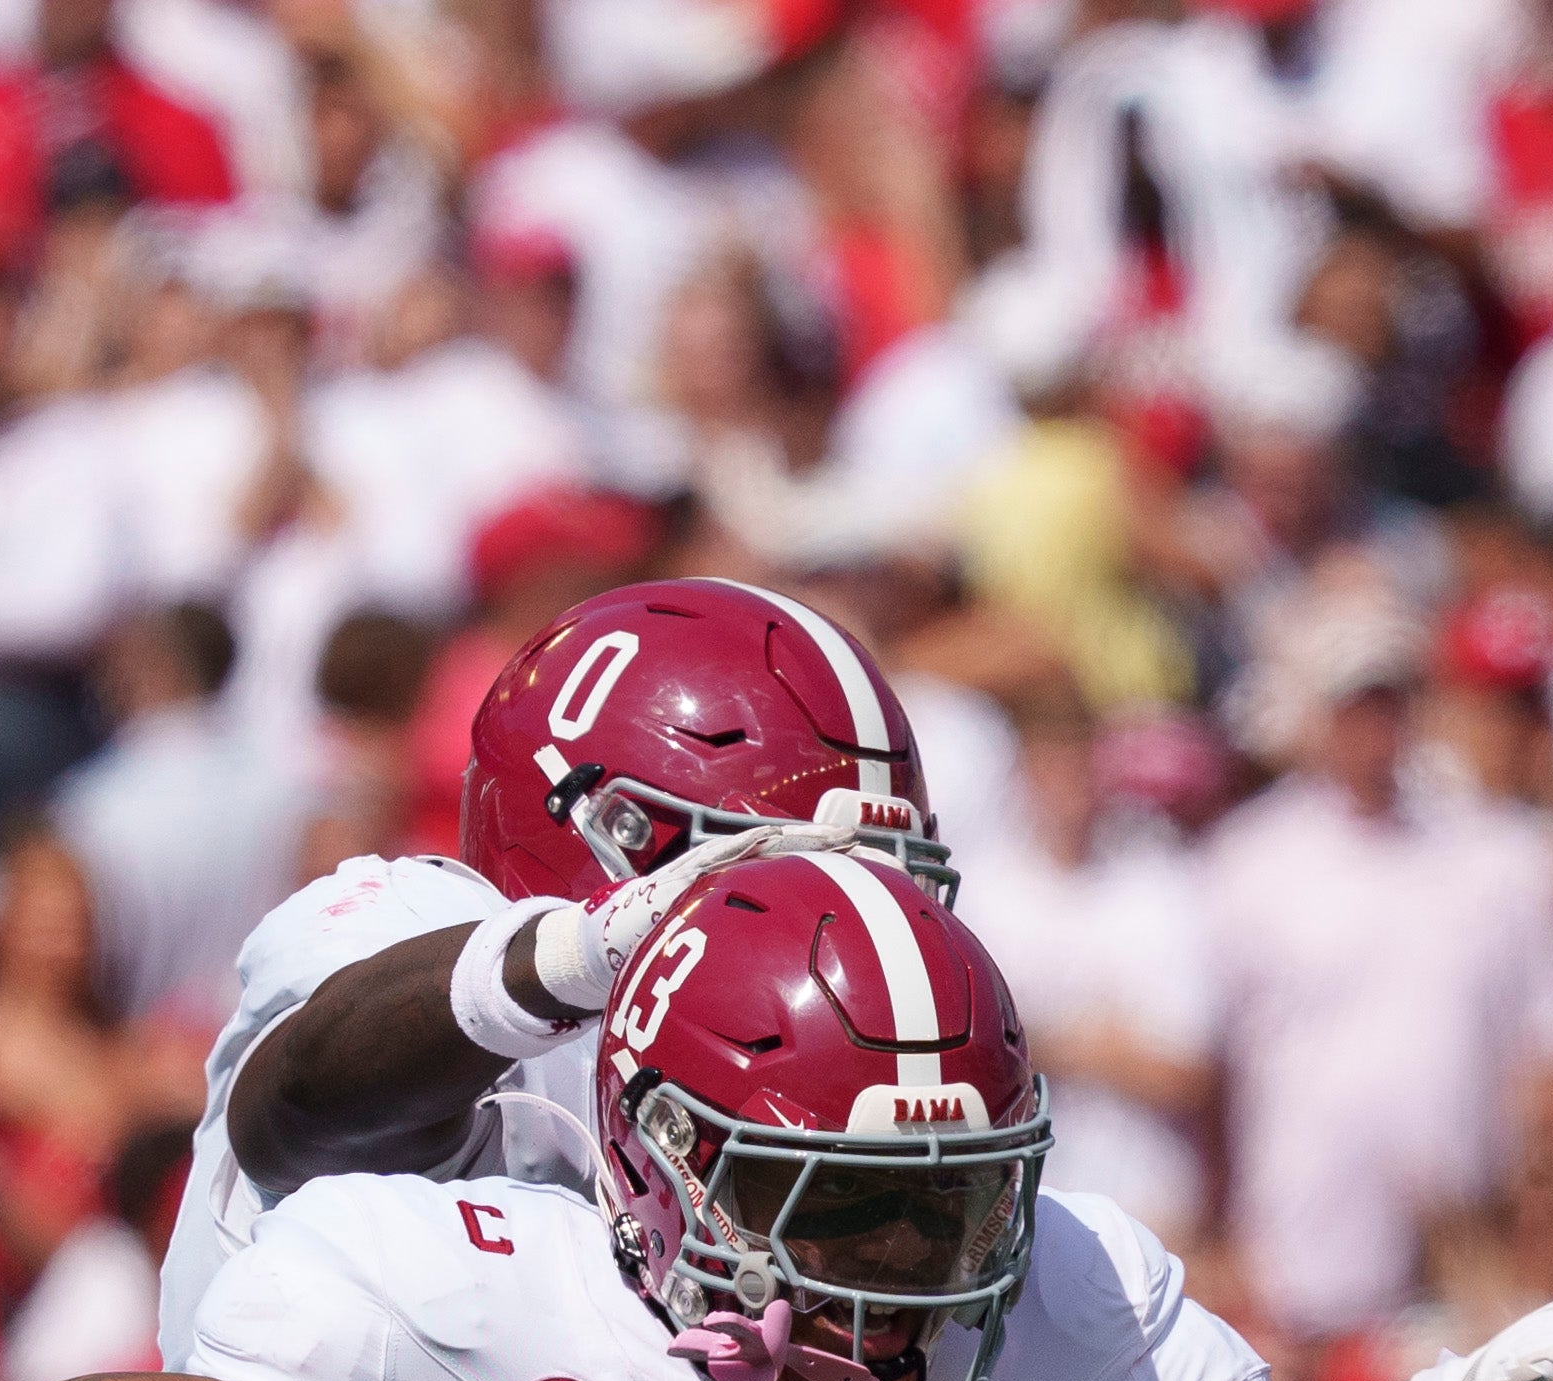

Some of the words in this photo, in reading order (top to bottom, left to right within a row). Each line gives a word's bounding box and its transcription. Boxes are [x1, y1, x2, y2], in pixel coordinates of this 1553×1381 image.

[547, 630, 640, 742] 0
[859, 801, 912, 831] BAMA
[610, 914, 708, 1053] 13
[893, 1096, 966, 1123] BAMA
[457, 1199, 515, 1256] C
